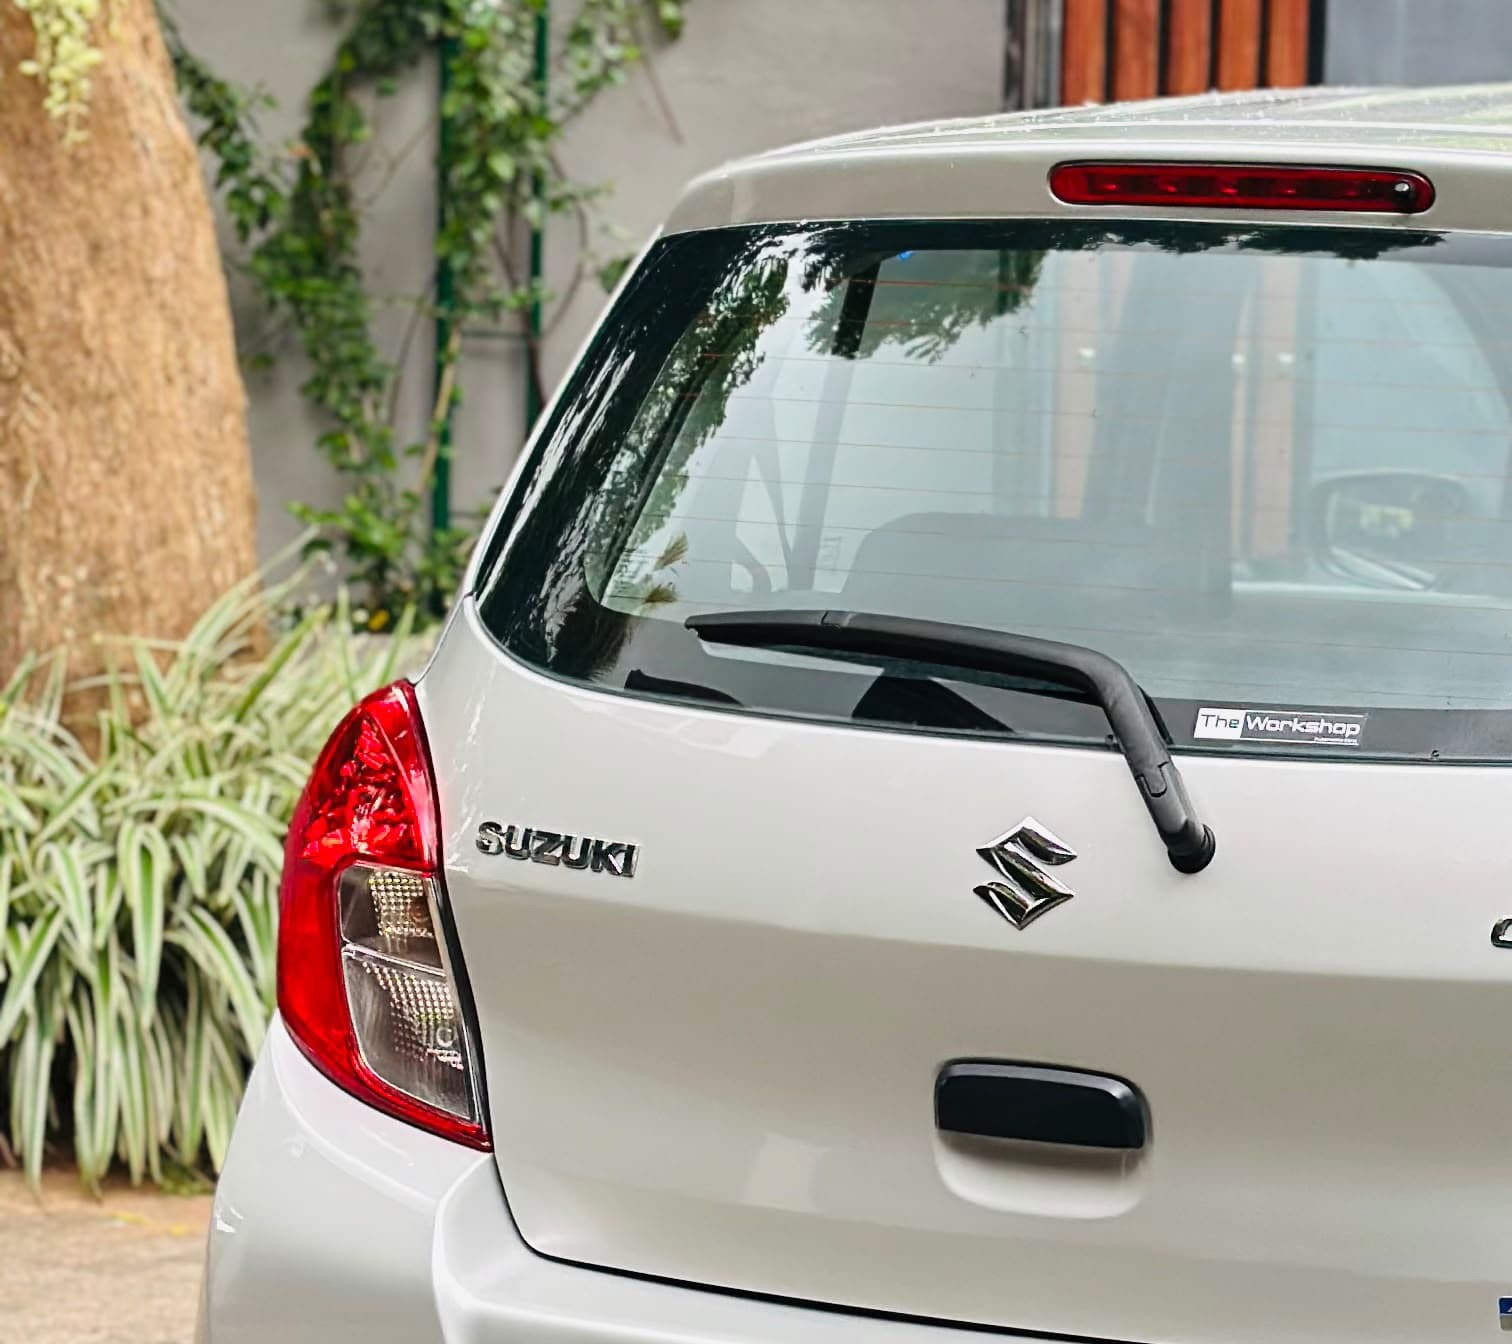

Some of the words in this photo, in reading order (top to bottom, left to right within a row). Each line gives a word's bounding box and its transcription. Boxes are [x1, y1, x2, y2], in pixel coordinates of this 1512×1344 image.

[1201, 714, 1240, 729] The
[1246, 715, 1361, 738] Workshop
[476, 821, 639, 878] SUZUKI
